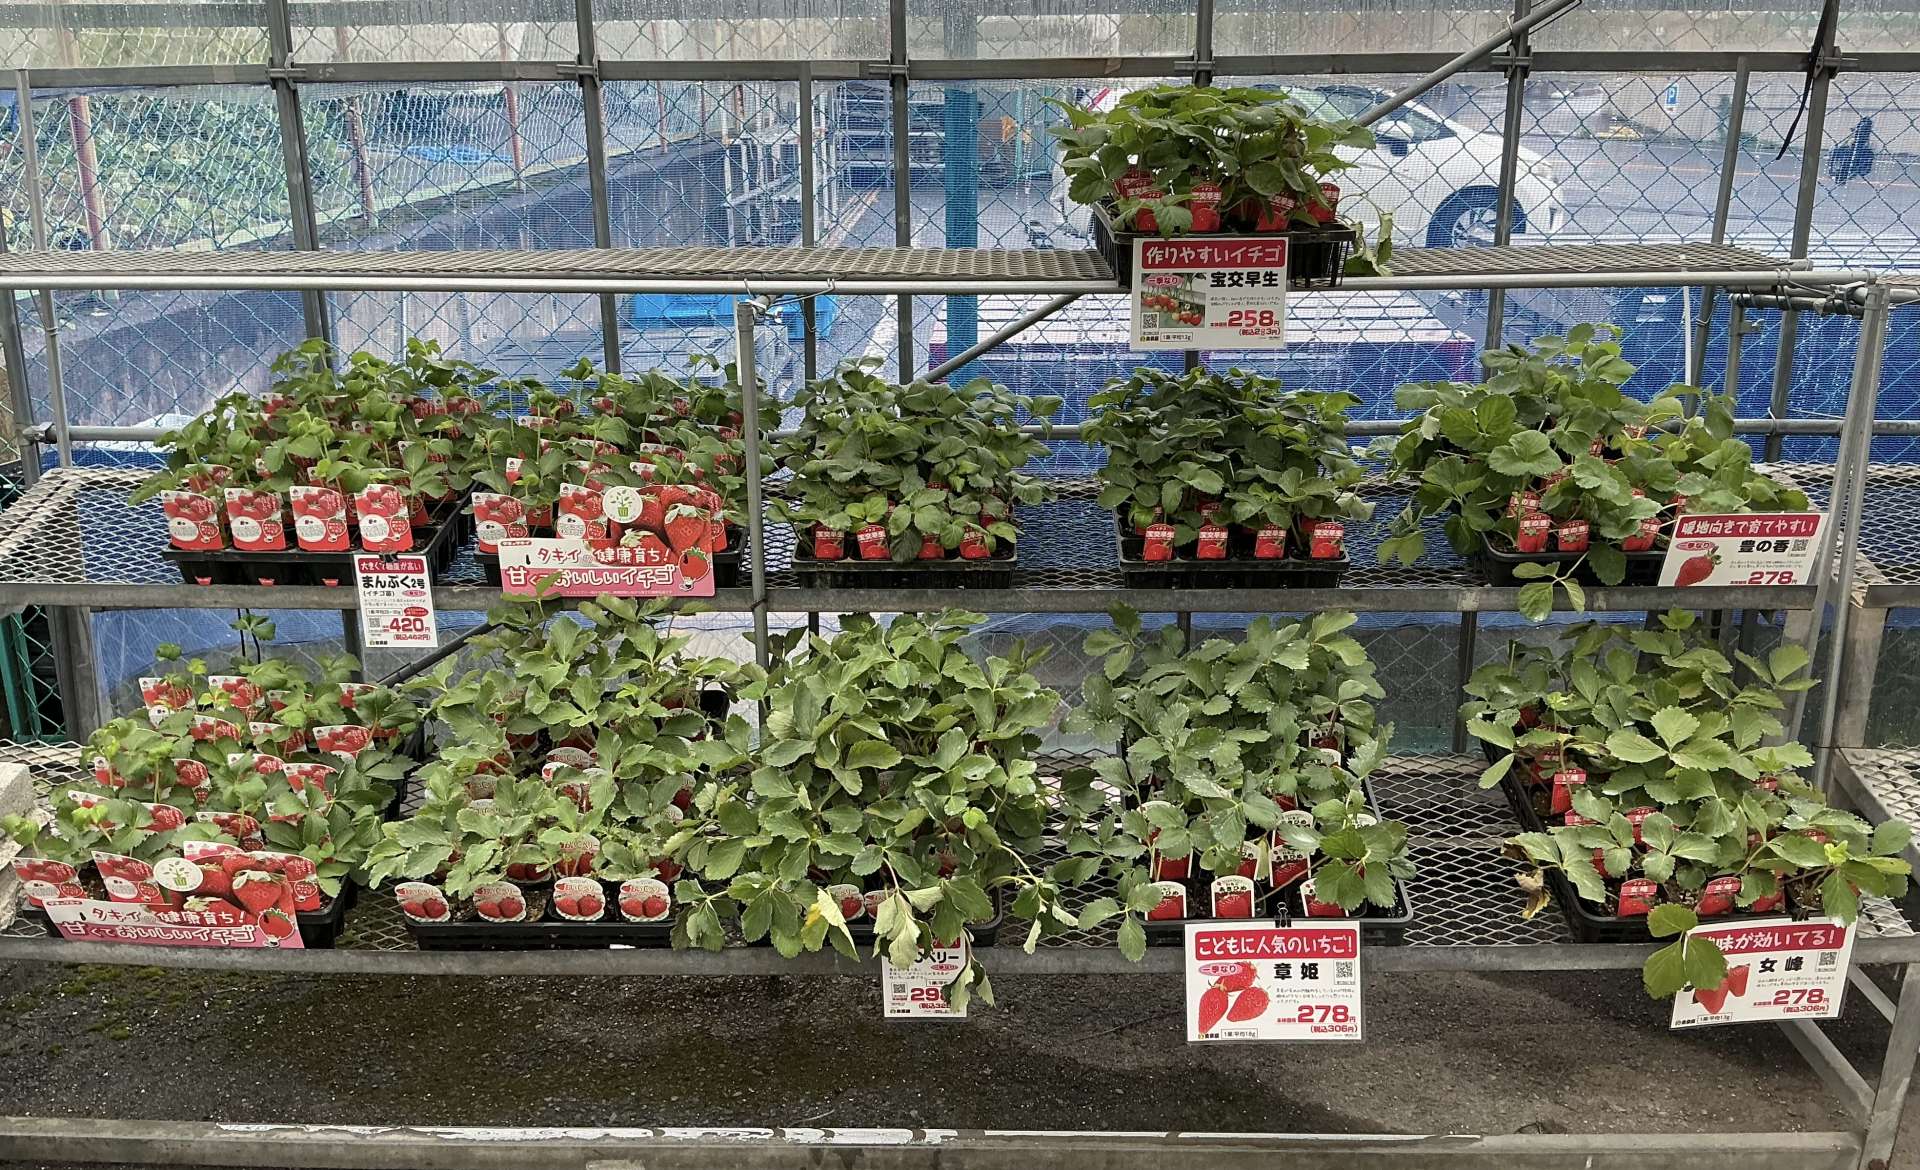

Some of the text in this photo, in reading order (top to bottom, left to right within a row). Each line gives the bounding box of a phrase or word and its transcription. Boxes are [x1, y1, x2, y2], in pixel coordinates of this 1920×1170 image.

[1147, 245, 1282, 265] 作りやすいイチゴ
[1210, 271, 1279, 288] 宝交早生
[1228, 310, 1280, 328] 258円
[1681, 519, 1814, 535] 暖地向きで育てやすい
[1738, 540, 1790, 553] 豊の香
[361, 575, 425, 589] まんぷく2号
[389, 618, 431, 632] 420円
[63, 921, 256, 943] 甘くておいしいイチゴ
[1706, 929, 1834, 951] 味が効いてる!
[1199, 934, 1353, 955] こどもに人気のいちご!
[1274, 962, 1319, 980] 章姫
[1759, 956, 1805, 973] 女峰
[910, 987, 947, 1001] 29
[1772, 988, 1830, 1006] 278円
[1297, 1005, 1356, 1023] 278円
[1310, 1024, 1358, 1033] (税込306円)
